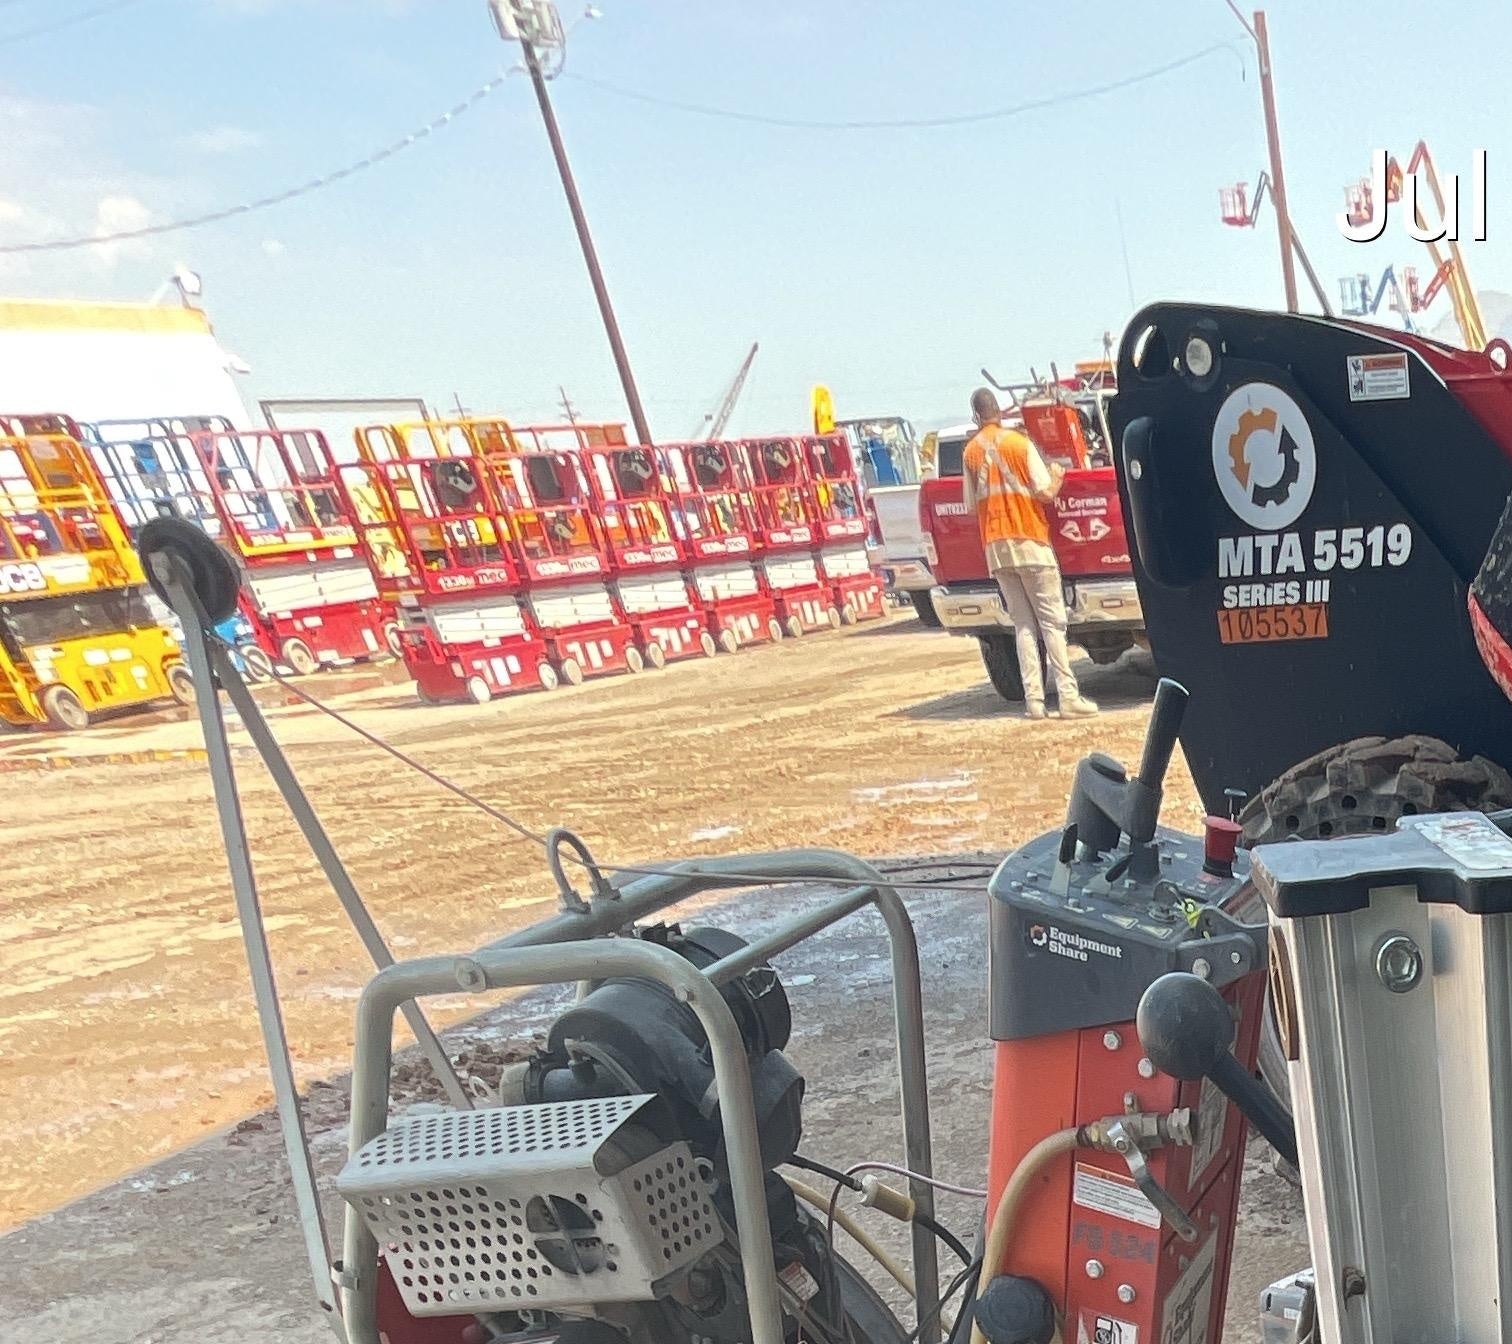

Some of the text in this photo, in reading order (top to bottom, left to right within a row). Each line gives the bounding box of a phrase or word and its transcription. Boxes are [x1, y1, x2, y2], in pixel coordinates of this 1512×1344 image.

[1218, 523, 1412, 578] MTA 5519
[1306, 579, 1331, 603] III
[1048, 940, 1089, 962] Share
[1049, 926, 1123, 959] Equipment
